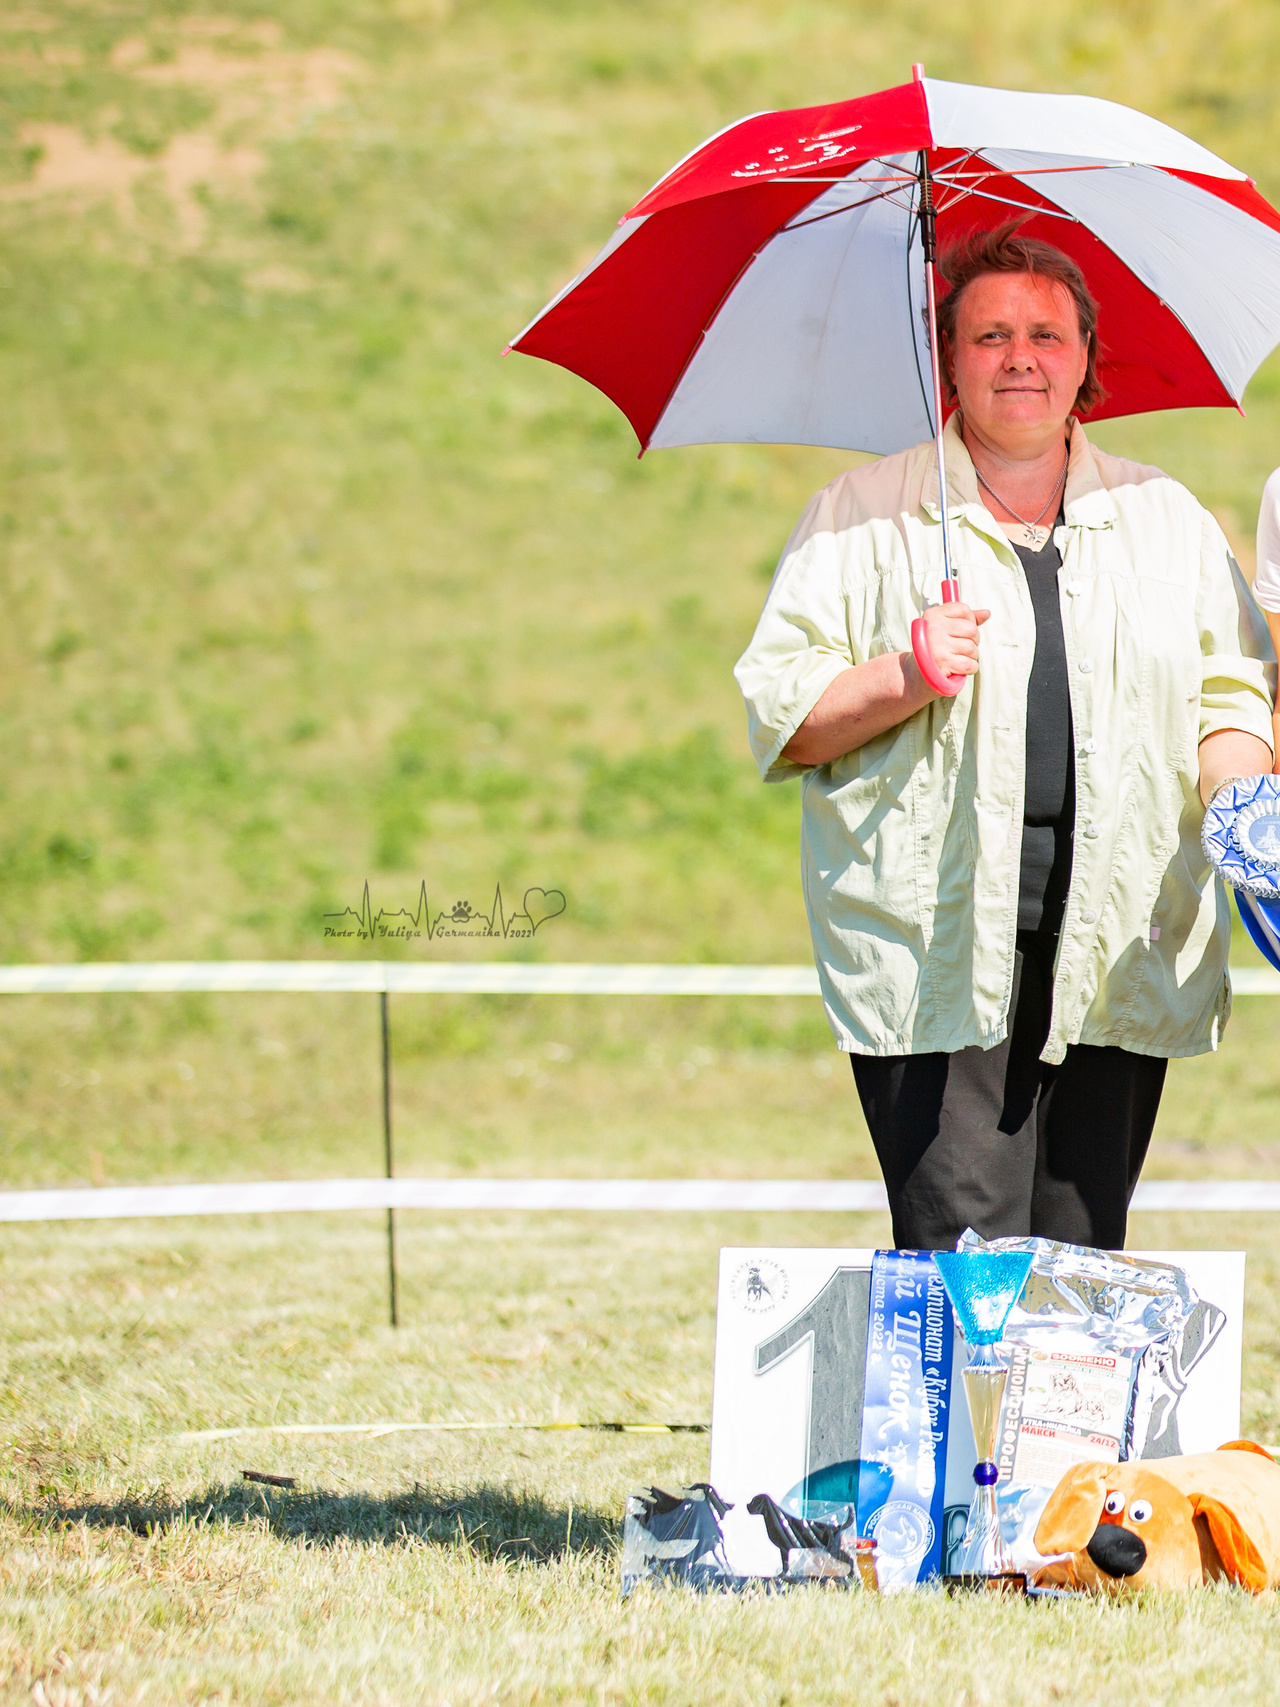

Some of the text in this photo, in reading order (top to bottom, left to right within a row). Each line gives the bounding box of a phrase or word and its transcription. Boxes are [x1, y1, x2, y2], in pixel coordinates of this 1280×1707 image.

[872, 1311, 885, 1350] 2022
[1052, 1353, 1116, 1367] ЗООМЕНЮ
[877, 1310, 922, 1440] Щенок
[1021, 1425, 1056, 1438] МАКСИ
[1089, 1435, 1116, 1448] 24/12
